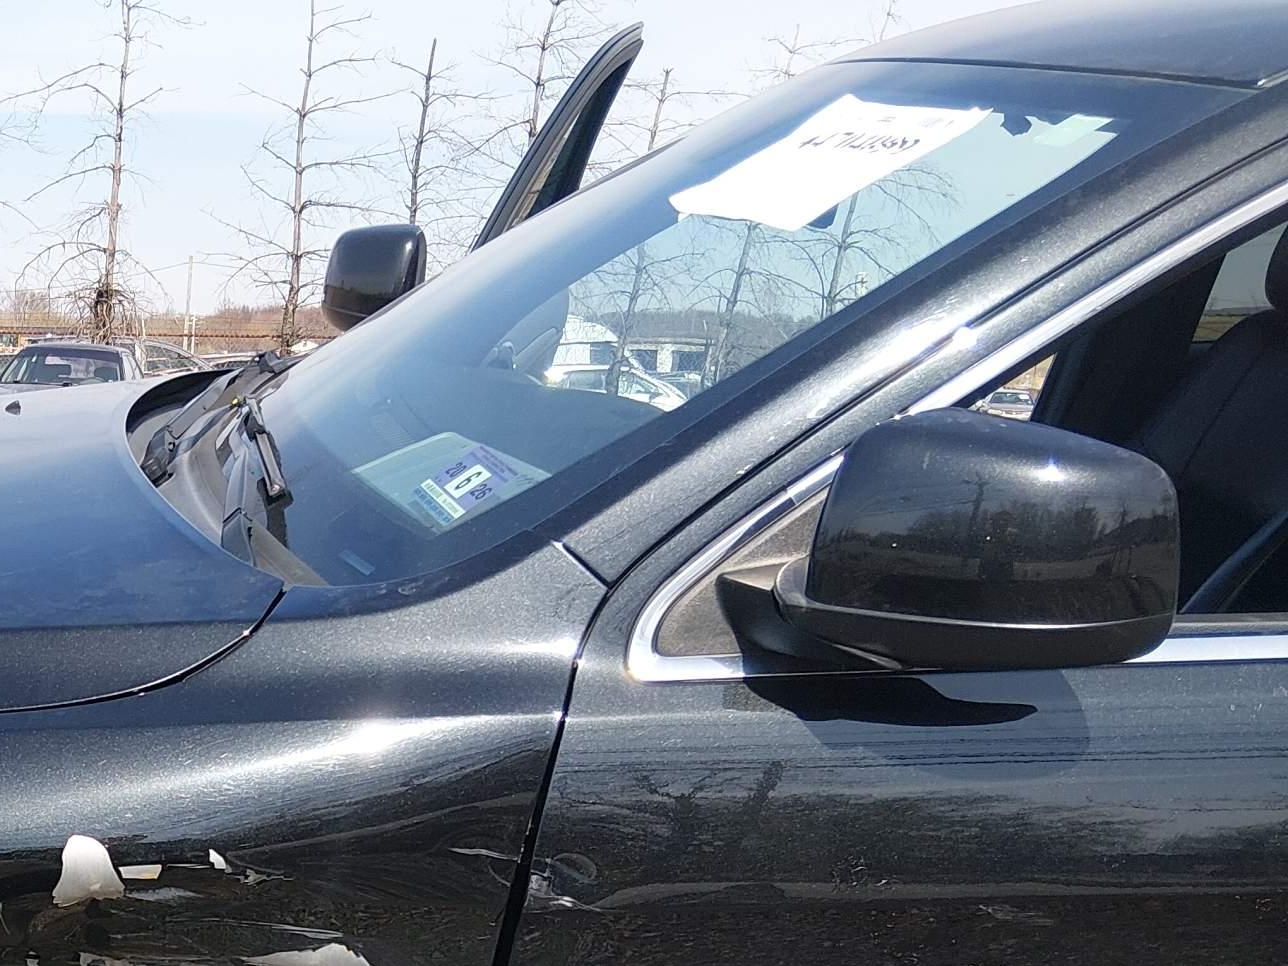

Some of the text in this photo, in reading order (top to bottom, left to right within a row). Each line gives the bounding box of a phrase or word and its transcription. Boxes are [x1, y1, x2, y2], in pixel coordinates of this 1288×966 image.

[445, 461, 468, 479] 20
[453, 470, 483, 491] 6
[469, 482, 493, 501] 26
